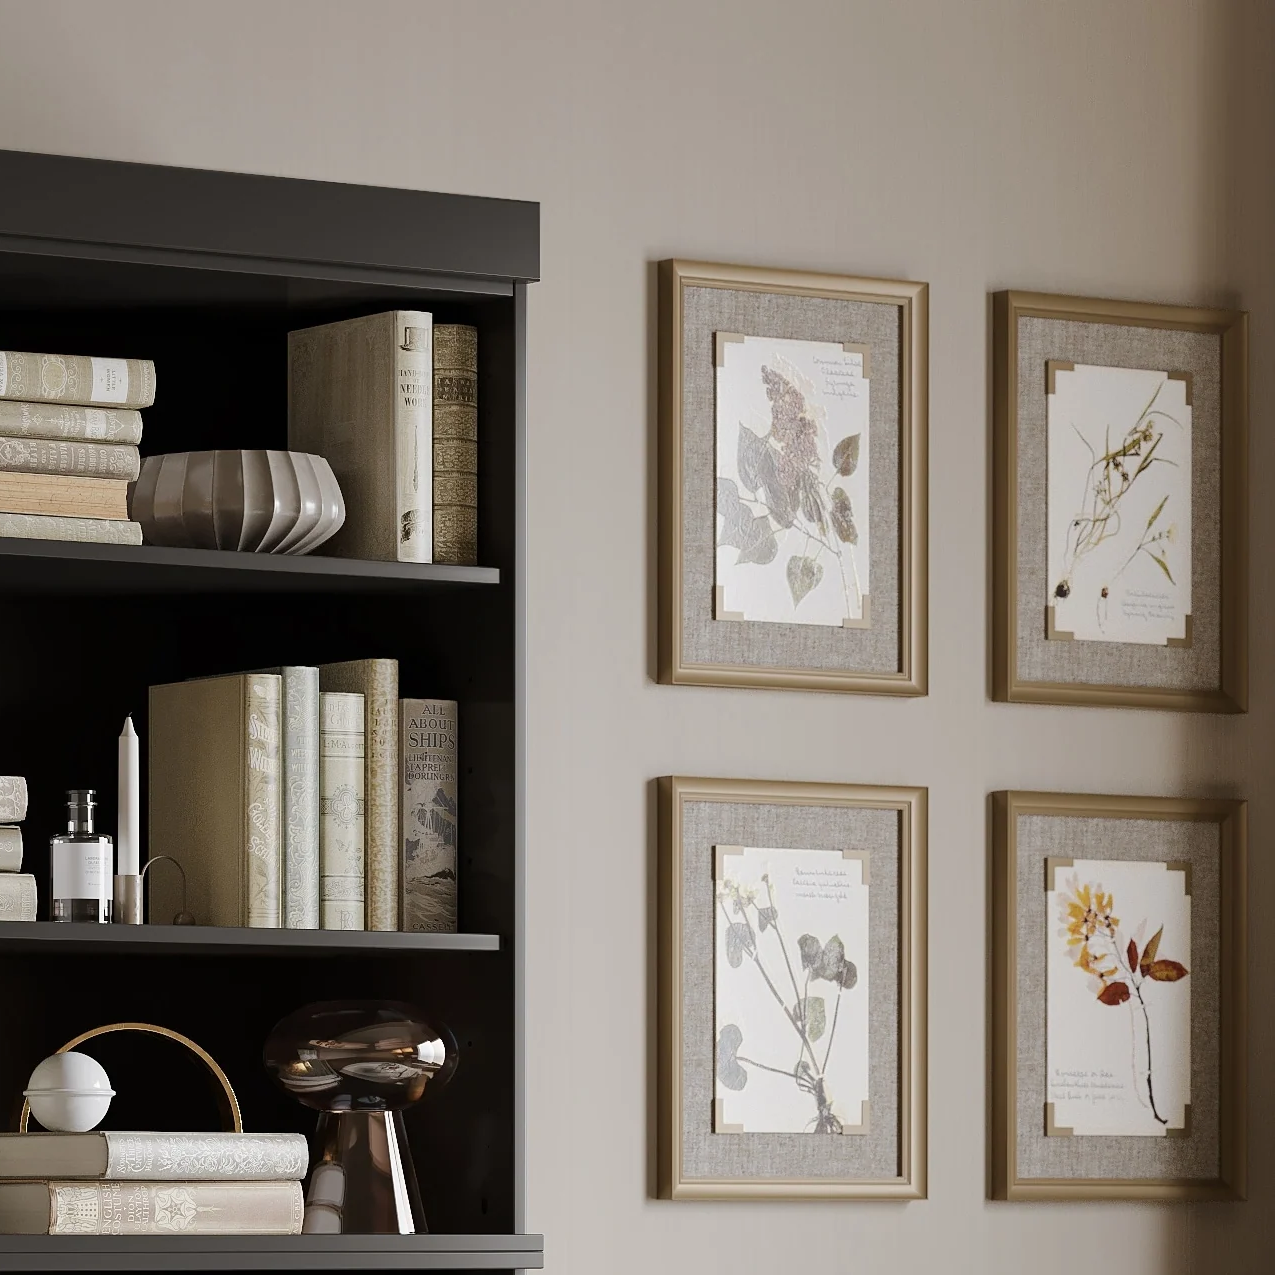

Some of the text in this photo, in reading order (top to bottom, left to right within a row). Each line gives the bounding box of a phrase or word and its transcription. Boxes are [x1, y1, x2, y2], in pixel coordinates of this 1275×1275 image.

[408, 718, 455, 731] ABOUT
[421, 704, 446, 716] ALL
[408, 732, 456, 750] SHIPS
[101, 1184, 113, 1234] ENGLISH
[111, 1183, 122, 1235] COSTUME
[127, 1195, 135, 1222] DION
[134, 1187, 142, 1230] CLAYTON
[141, 1185, 150, 1232] CALTHROP
